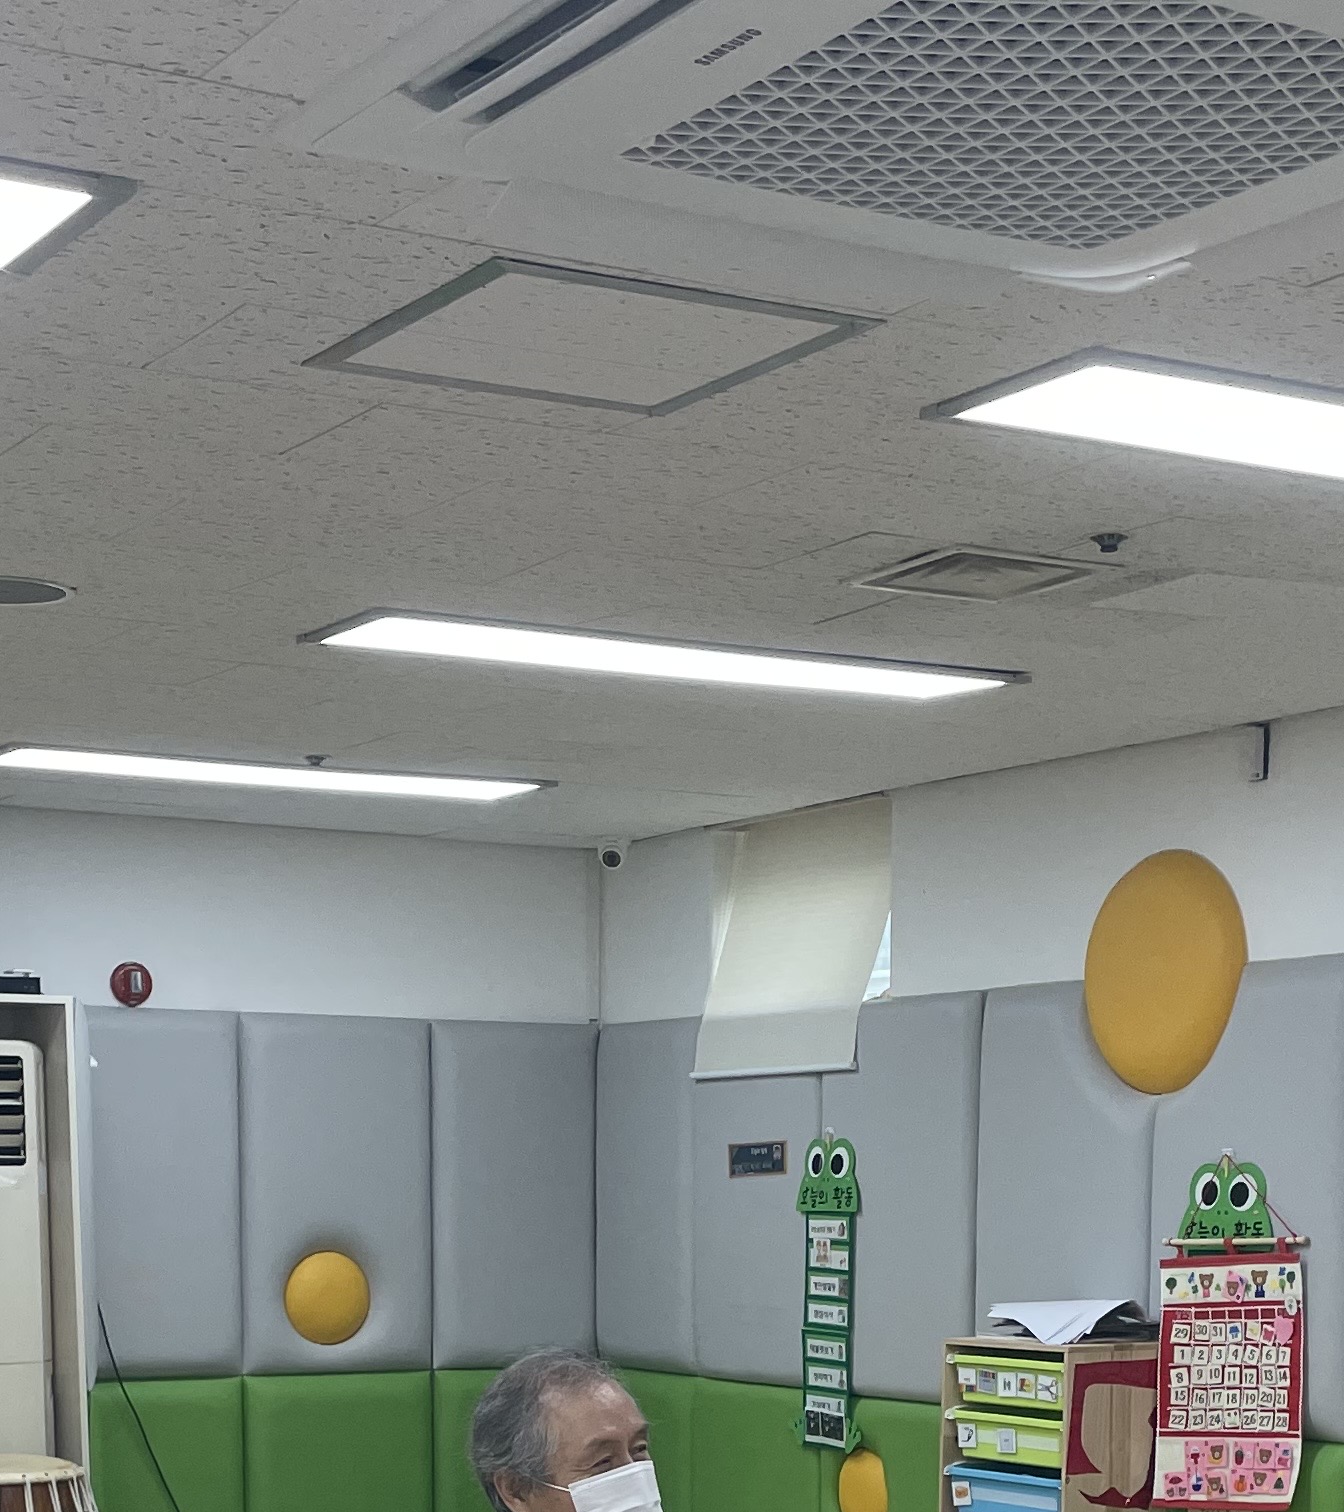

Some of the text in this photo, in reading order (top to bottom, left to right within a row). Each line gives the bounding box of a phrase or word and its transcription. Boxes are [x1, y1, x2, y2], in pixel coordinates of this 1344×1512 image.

[694, 28, 762, 66] SAMSUNG
[800, 1186, 854, 1209] 오늘의 활동
[1174, 1325, 1222, 1338] 29 30 31
[1180, 1349, 1286, 1361] 1 2 3 4 5 6 7
[1176, 1368, 1287, 1384] 8 9 10 11 12 13 14
[1175, 1391, 1285, 1404] 15 16 17 18 19 20 21
[1171, 1414, 1287, 1427] 22 23 24 26 27 28
